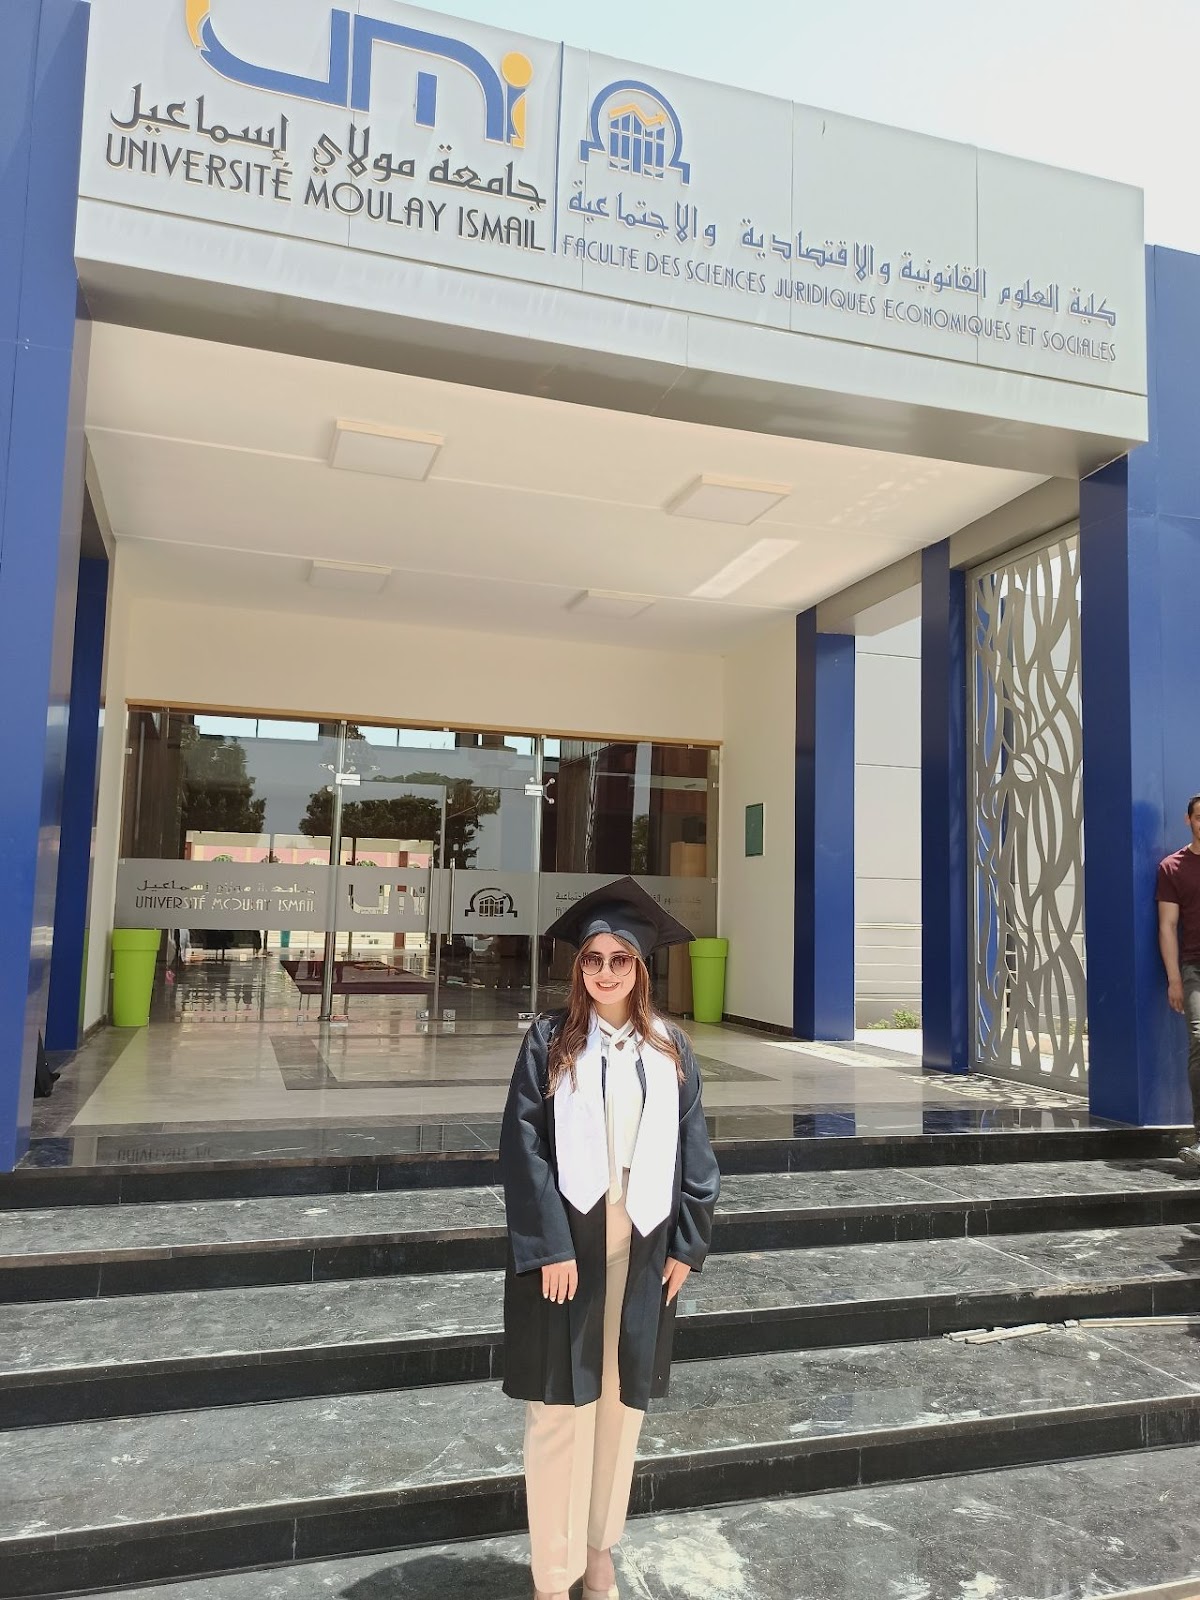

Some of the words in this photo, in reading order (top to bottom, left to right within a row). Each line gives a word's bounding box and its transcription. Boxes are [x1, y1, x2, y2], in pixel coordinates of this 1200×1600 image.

[110, 83, 289, 162] إسماعيل
[312, 123, 416, 184] مولاي
[105, 132, 293, 202] UNIVERSITÉ
[303, 176, 447, 232] MOULAY
[457, 205, 546, 252] ISMAIL
[428, 144, 547, 213] جامعة
[568, 180, 717, 247] والاجتماعية
[563, 234, 640, 270] FACULTE
[645, 252, 681, 277] DES
[686, 259, 767, 294] SCIENCES
[774, 277, 876, 316] JURIDIQUES
[884, 298, 1012, 341] ECONOMIQUES
[1018, 325, 1037, 346] ET
[1042, 330, 1117, 362] SOCIALES
[899, 250, 988, 299] القانونية
[998, 278, 1060, 313] العلوم
[1068, 286, 1117, 328] كلية
[135, 894, 206, 910] UNIVERSITÉ
